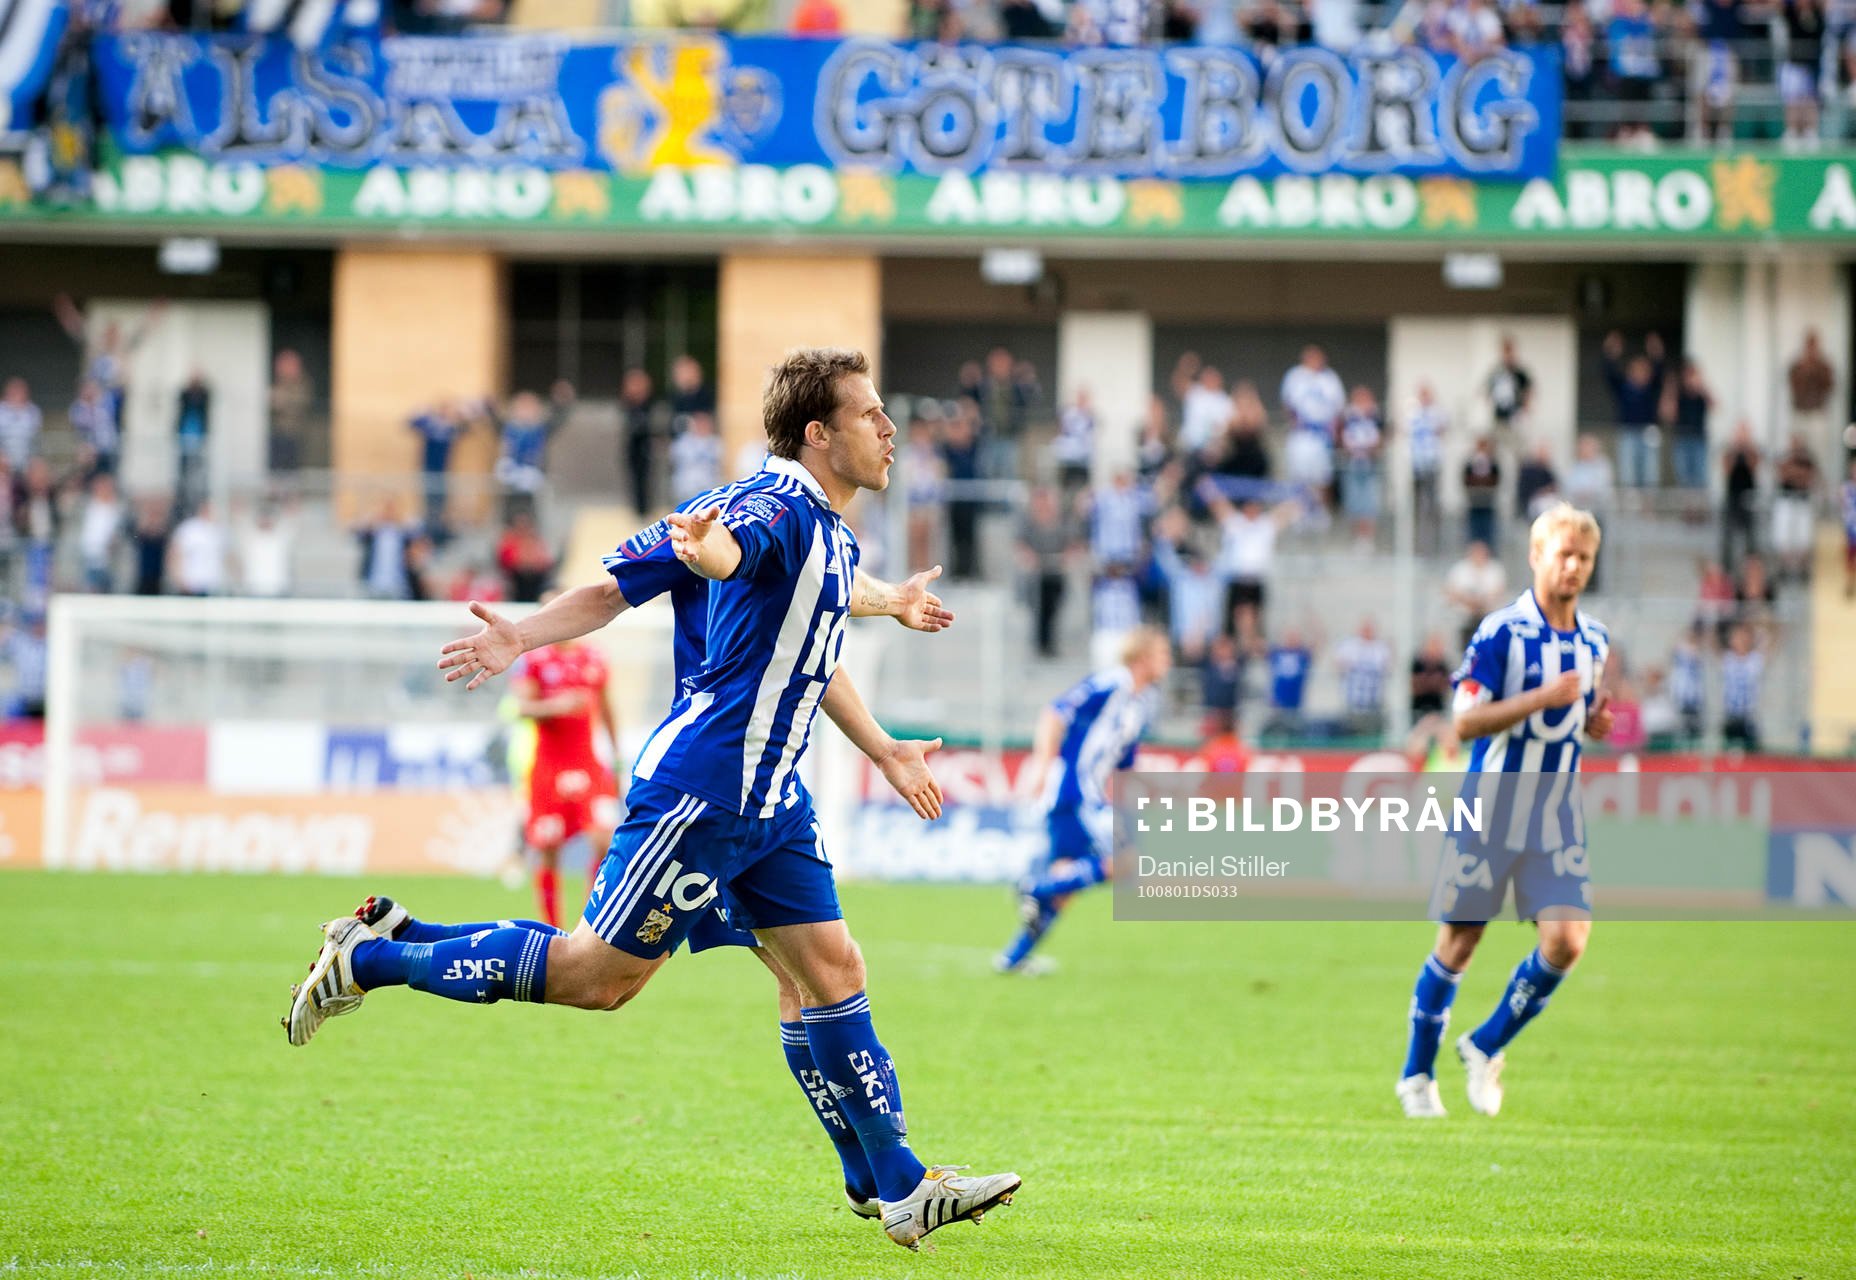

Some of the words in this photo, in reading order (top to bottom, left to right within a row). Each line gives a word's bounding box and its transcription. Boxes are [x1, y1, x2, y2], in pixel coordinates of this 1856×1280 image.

[813, 38, 1539, 174] GÖTEBORG
[443, 957, 506, 982] SKF
[799, 1068, 848, 1130] SKF
[847, 1049, 891, 1115] SKF
